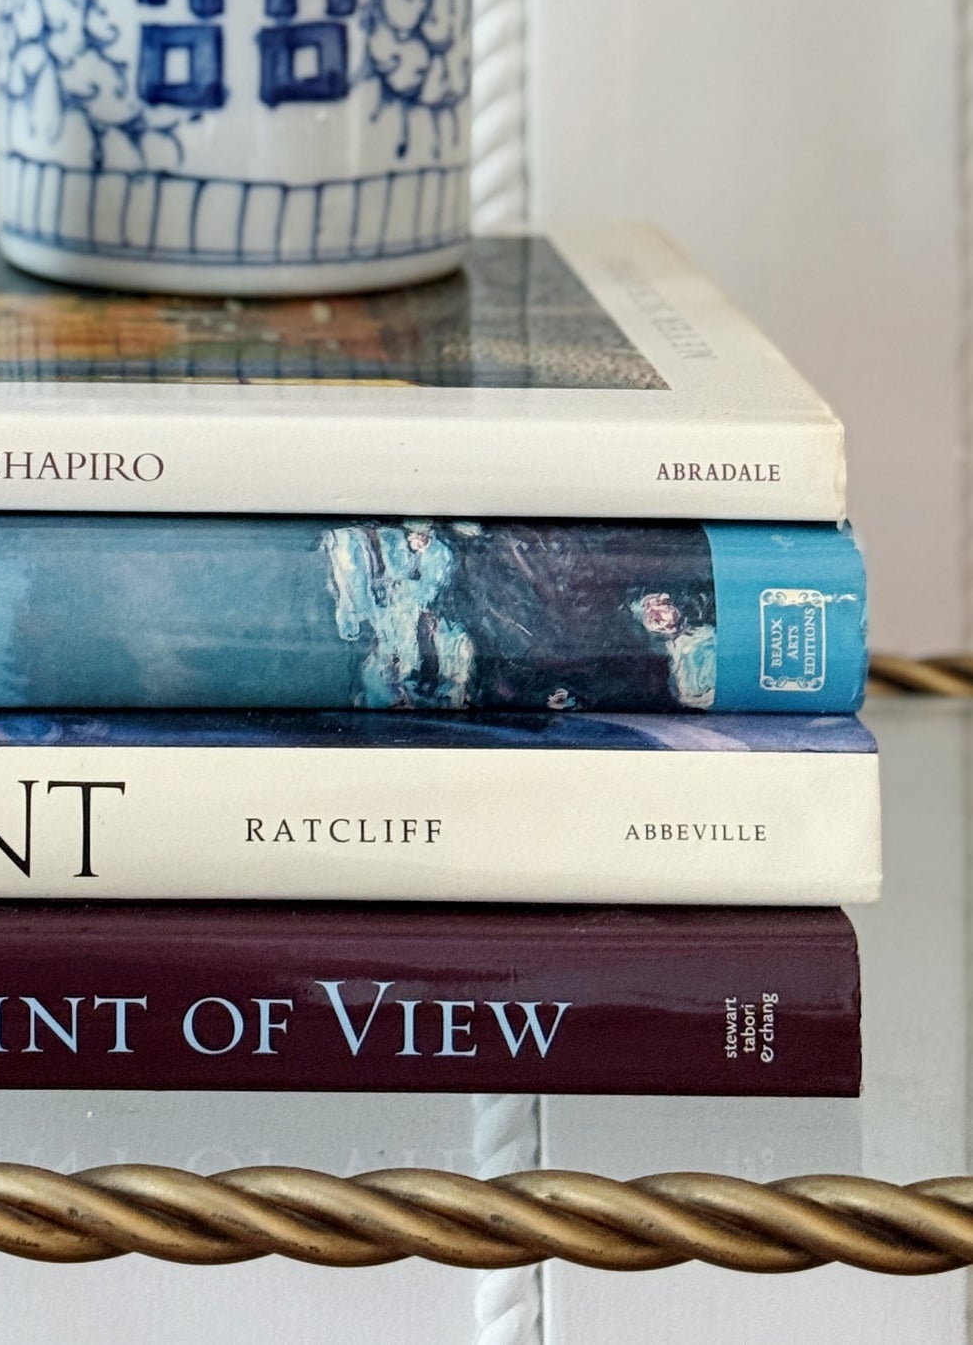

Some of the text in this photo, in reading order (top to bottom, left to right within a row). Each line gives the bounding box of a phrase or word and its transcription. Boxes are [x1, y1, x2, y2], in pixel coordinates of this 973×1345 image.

[656, 462, 780, 482] ABRADALE
[770, 616, 783, 667] BEAUX
[786, 625, 800, 661] ARTS
[803, 606, 816, 676] EDITIONS
[245, 817, 442, 844] RATCLIFF
[625, 823, 766, 842] ABBEVILLE
[182, 996, 294, 1055] OF
[314, 980, 573, 1059] VIEW
[724, 996, 738, 1059] stewart
[739, 1003, 756, 1053] tabori
[758, 992, 780, 1063] & chang
